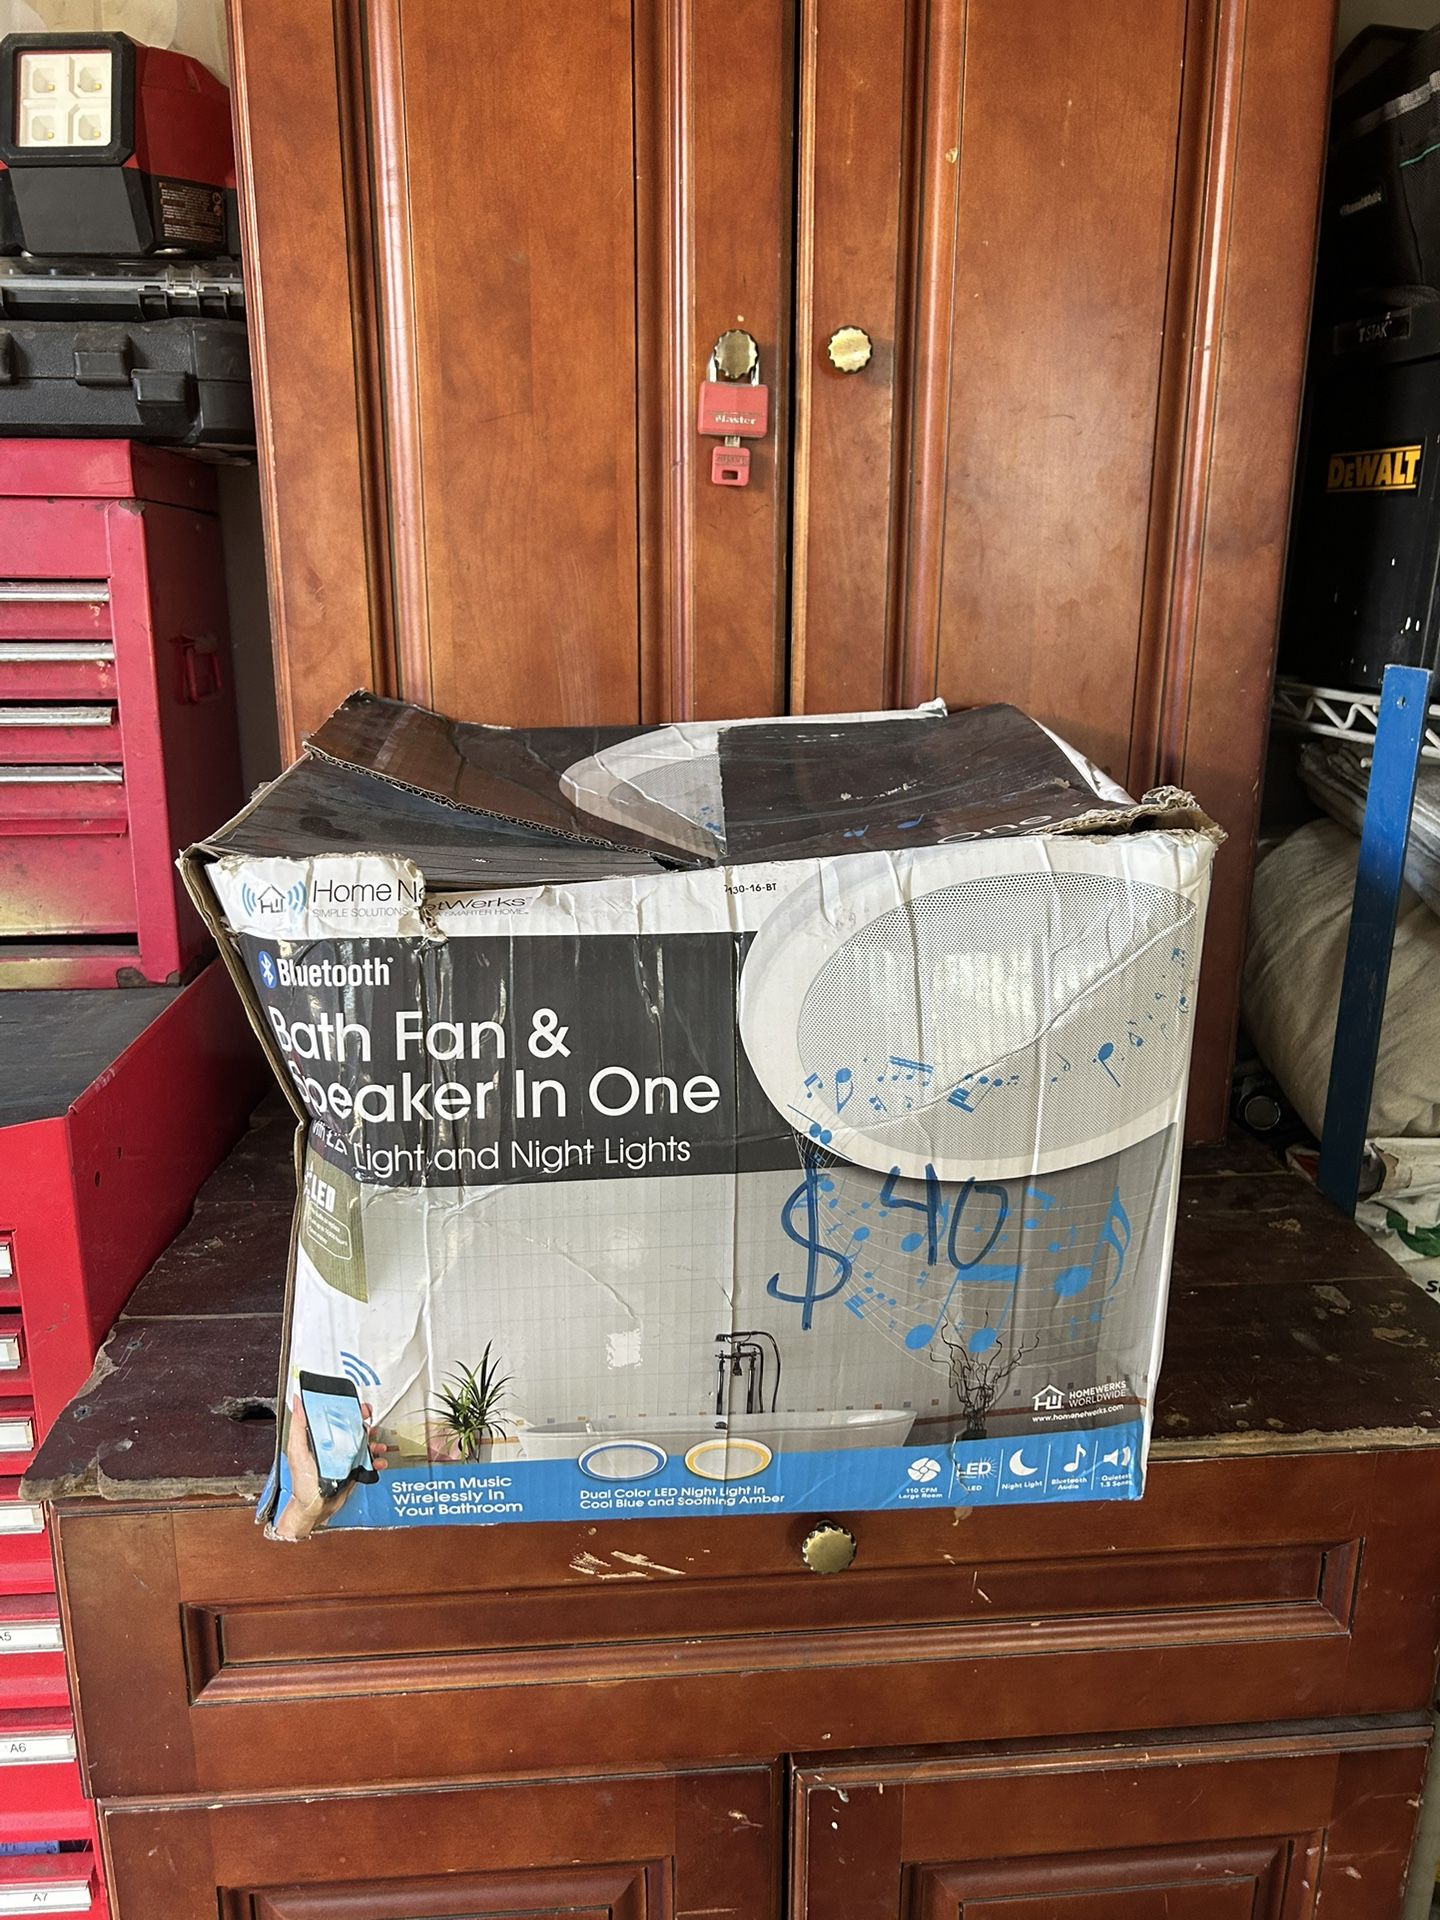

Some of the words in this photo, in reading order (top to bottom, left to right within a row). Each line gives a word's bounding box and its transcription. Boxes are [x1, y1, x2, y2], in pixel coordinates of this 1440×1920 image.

[313, 879, 391, 902] Home
[312, 908, 348, 918] SIMPLE
[446, 909, 492, 917] SMARTER
[276, 957, 391, 987] Bluetooth
[268, 1006, 371, 1062] Bath
[396, 1011, 505, 1061] Fan
[528, 1008, 571, 1058] &
[288, 1060, 494, 1123] Speaker
[515, 1069, 566, 1118] In
[589, 1066, 720, 1116] One
[353, 1142, 425, 1178] Light
[434, 1142, 500, 1171] and
[511, 1138, 594, 1173] Night
[605, 1136, 691, 1170] Lights
[1068, 1389, 1126, 1408] WORLDWIDE
[1069, 1381, 1127, 1400] HOMEWERKS
[956, 1461, 992, 1478] LED
[391, 1480, 455, 1493] Stream
[459, 1476, 513, 1489] Music
[1001, 1482, 1022, 1491] Night
[1024, 1480, 1043, 1489] Light
[1051, 1477, 1088, 1486] Bluetooth
[393, 1490, 483, 1505] Wirelessly
[488, 1489, 504, 1500] In
[580, 1489, 611, 1500] Dual
[614, 1488, 651, 1498] Color
[654, 1487, 678, 1497] LED
[681, 1487, 717, 1498] Night
[720, 1486, 751, 1497] Light
[394, 1506, 435, 1517] Your
[438, 1502, 523, 1515] Bathroom
[580, 1499, 612, 1509] Cool
[615, 1498, 645, 1508] Blue
[647, 1497, 675, 1507] and
[677, 1497, 736, 1507] Soothing
[739, 1495, 785, 1504] Amber
[10, 1742, 27, 1753] A6
[32, 1892, 48, 1902] A7
